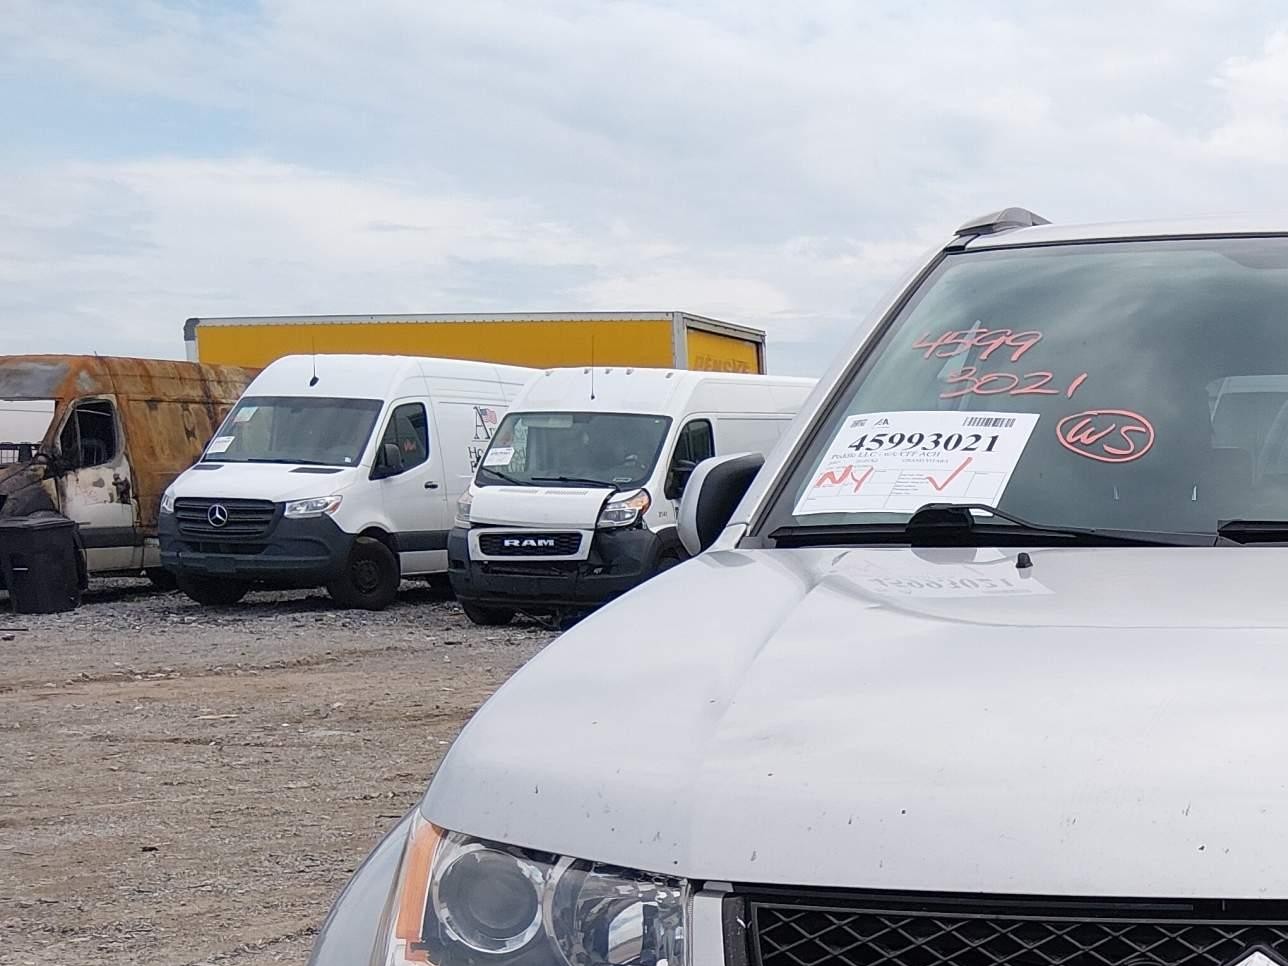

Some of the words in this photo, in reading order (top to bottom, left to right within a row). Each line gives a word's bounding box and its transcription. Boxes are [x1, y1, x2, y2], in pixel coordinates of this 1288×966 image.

[912, 328, 1044, 362] 4599
[940, 366, 1088, 399] 3021
[848, 432, 1000, 452] 45993021
[504, 539, 554, 547] RAM
